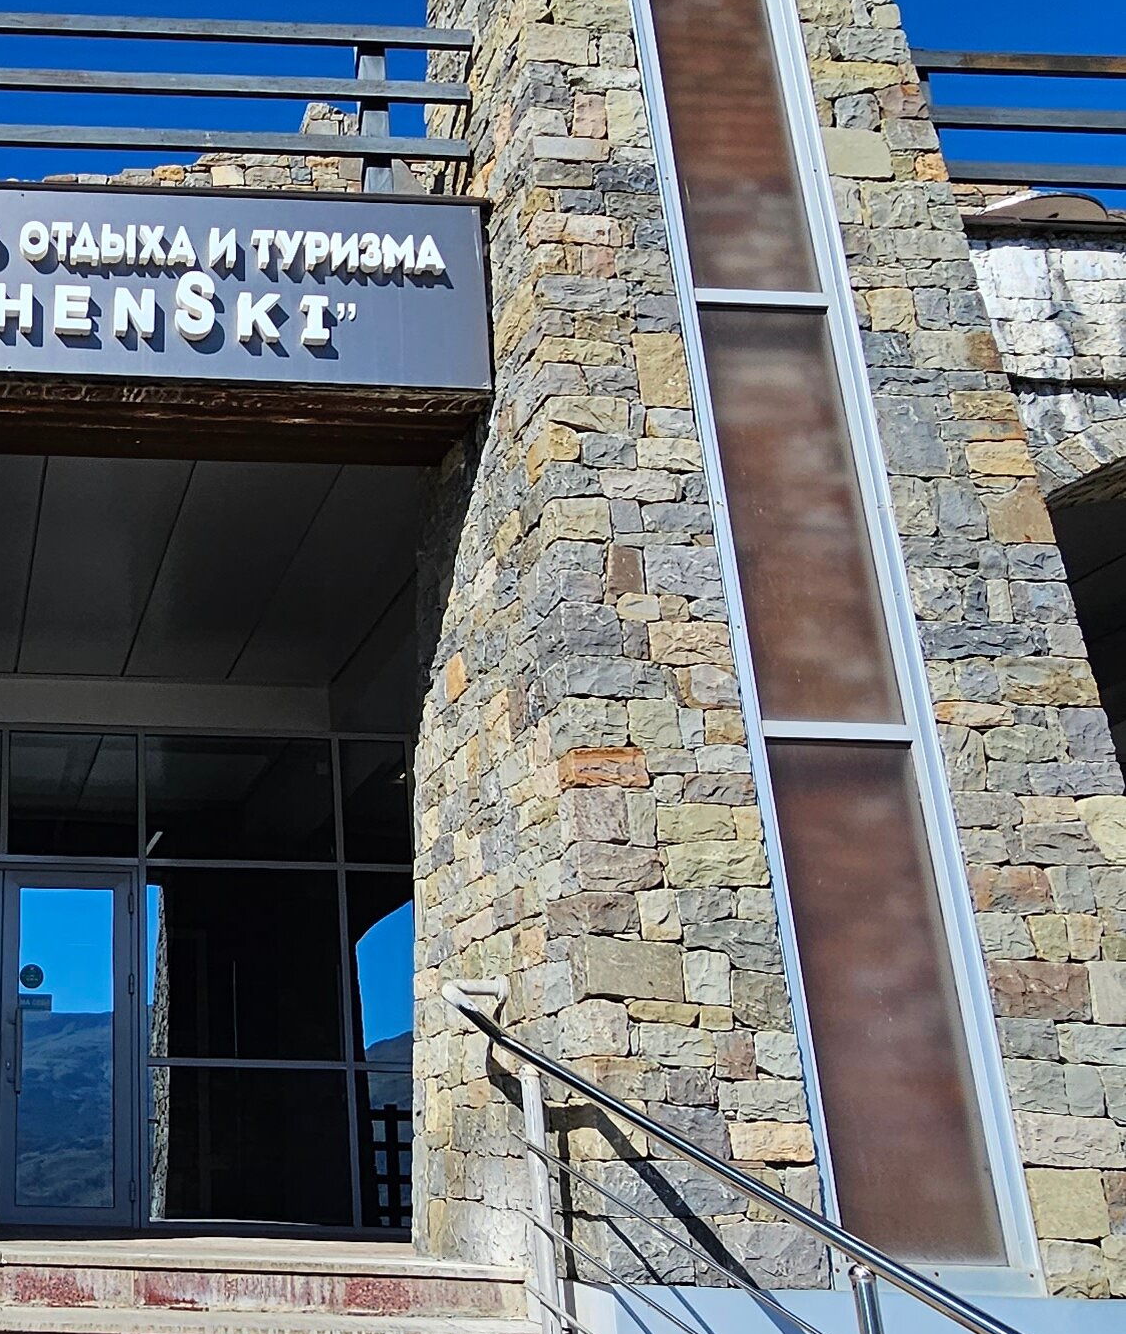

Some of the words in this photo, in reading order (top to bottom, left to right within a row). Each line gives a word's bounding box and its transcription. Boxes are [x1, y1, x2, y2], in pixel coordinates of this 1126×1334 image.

[20, 221, 197, 267] ОТДЫХА
[210, 227, 237, 268] И
[251, 229, 446, 275] ТУРИЗМА
